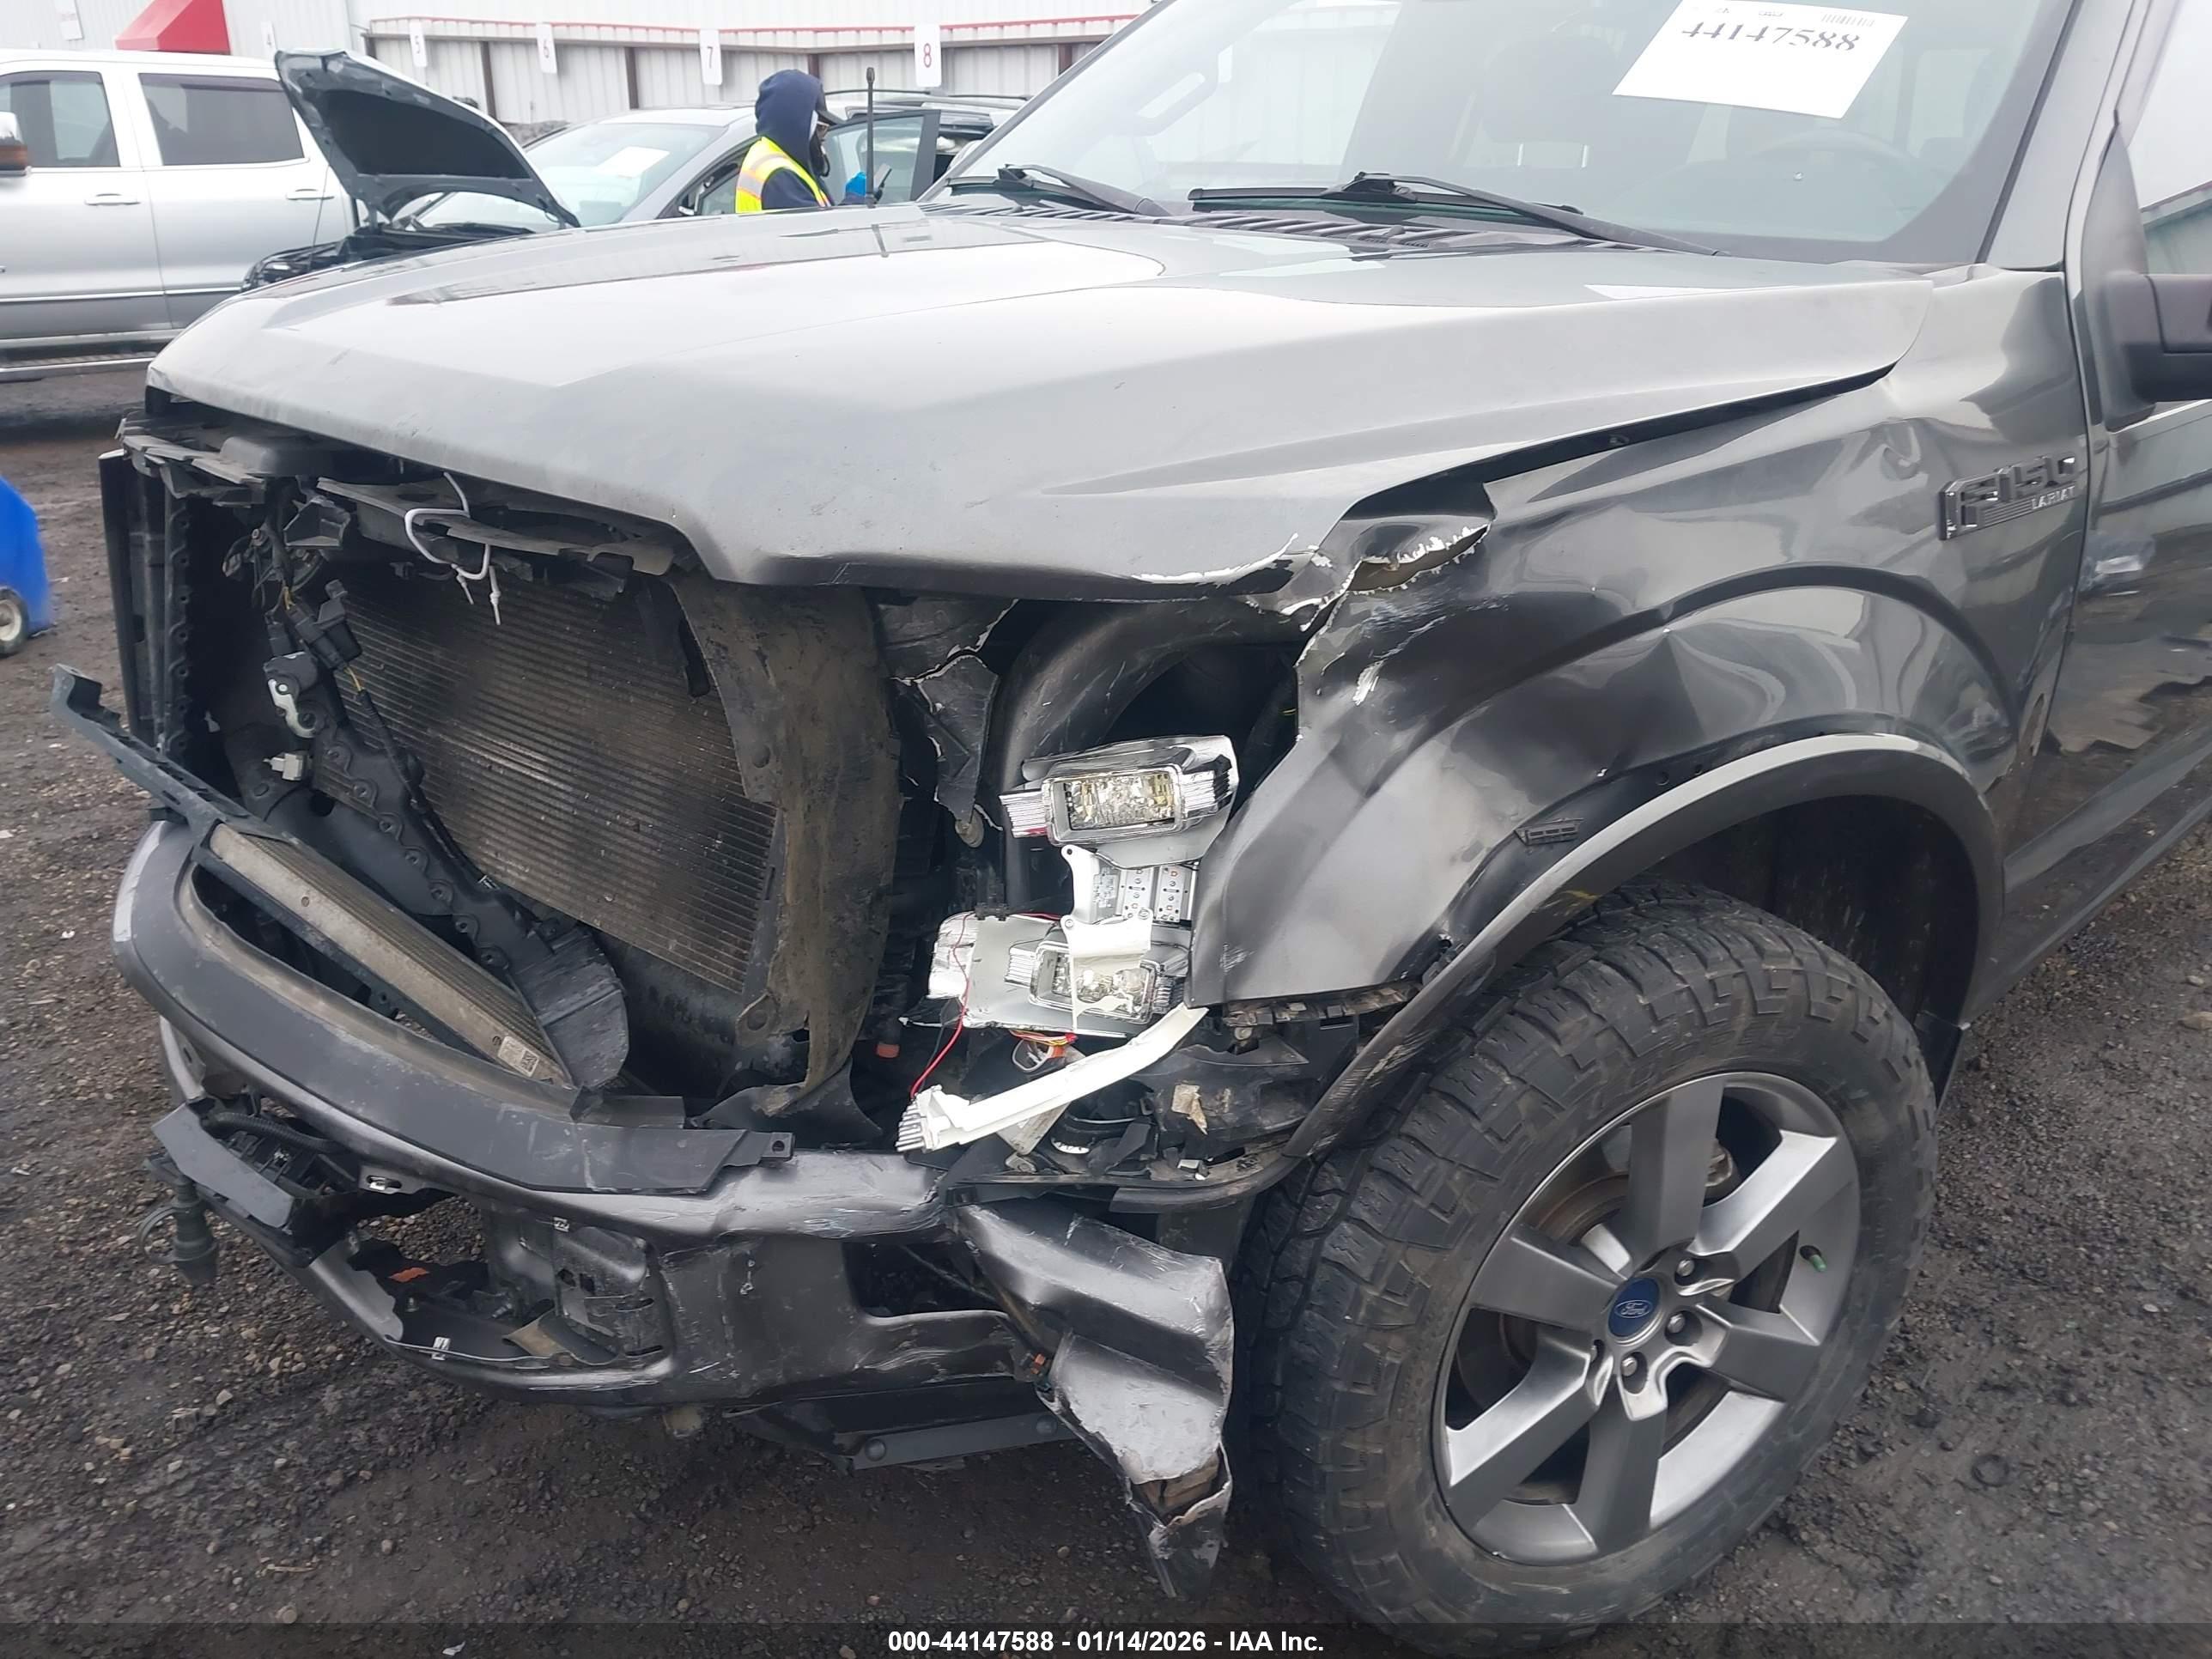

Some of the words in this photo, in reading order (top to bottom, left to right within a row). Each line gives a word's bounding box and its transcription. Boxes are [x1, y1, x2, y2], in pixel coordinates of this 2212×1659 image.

[1681, 21, 1861, 51] 44147588
[543, 39, 550, 58] 6
[707, 46, 714, 69] 7
[923, 43, 933, 68] 8
[2031, 485, 2076, 510] LARIAT
[1620, 1302, 1648, 1316] Ford
